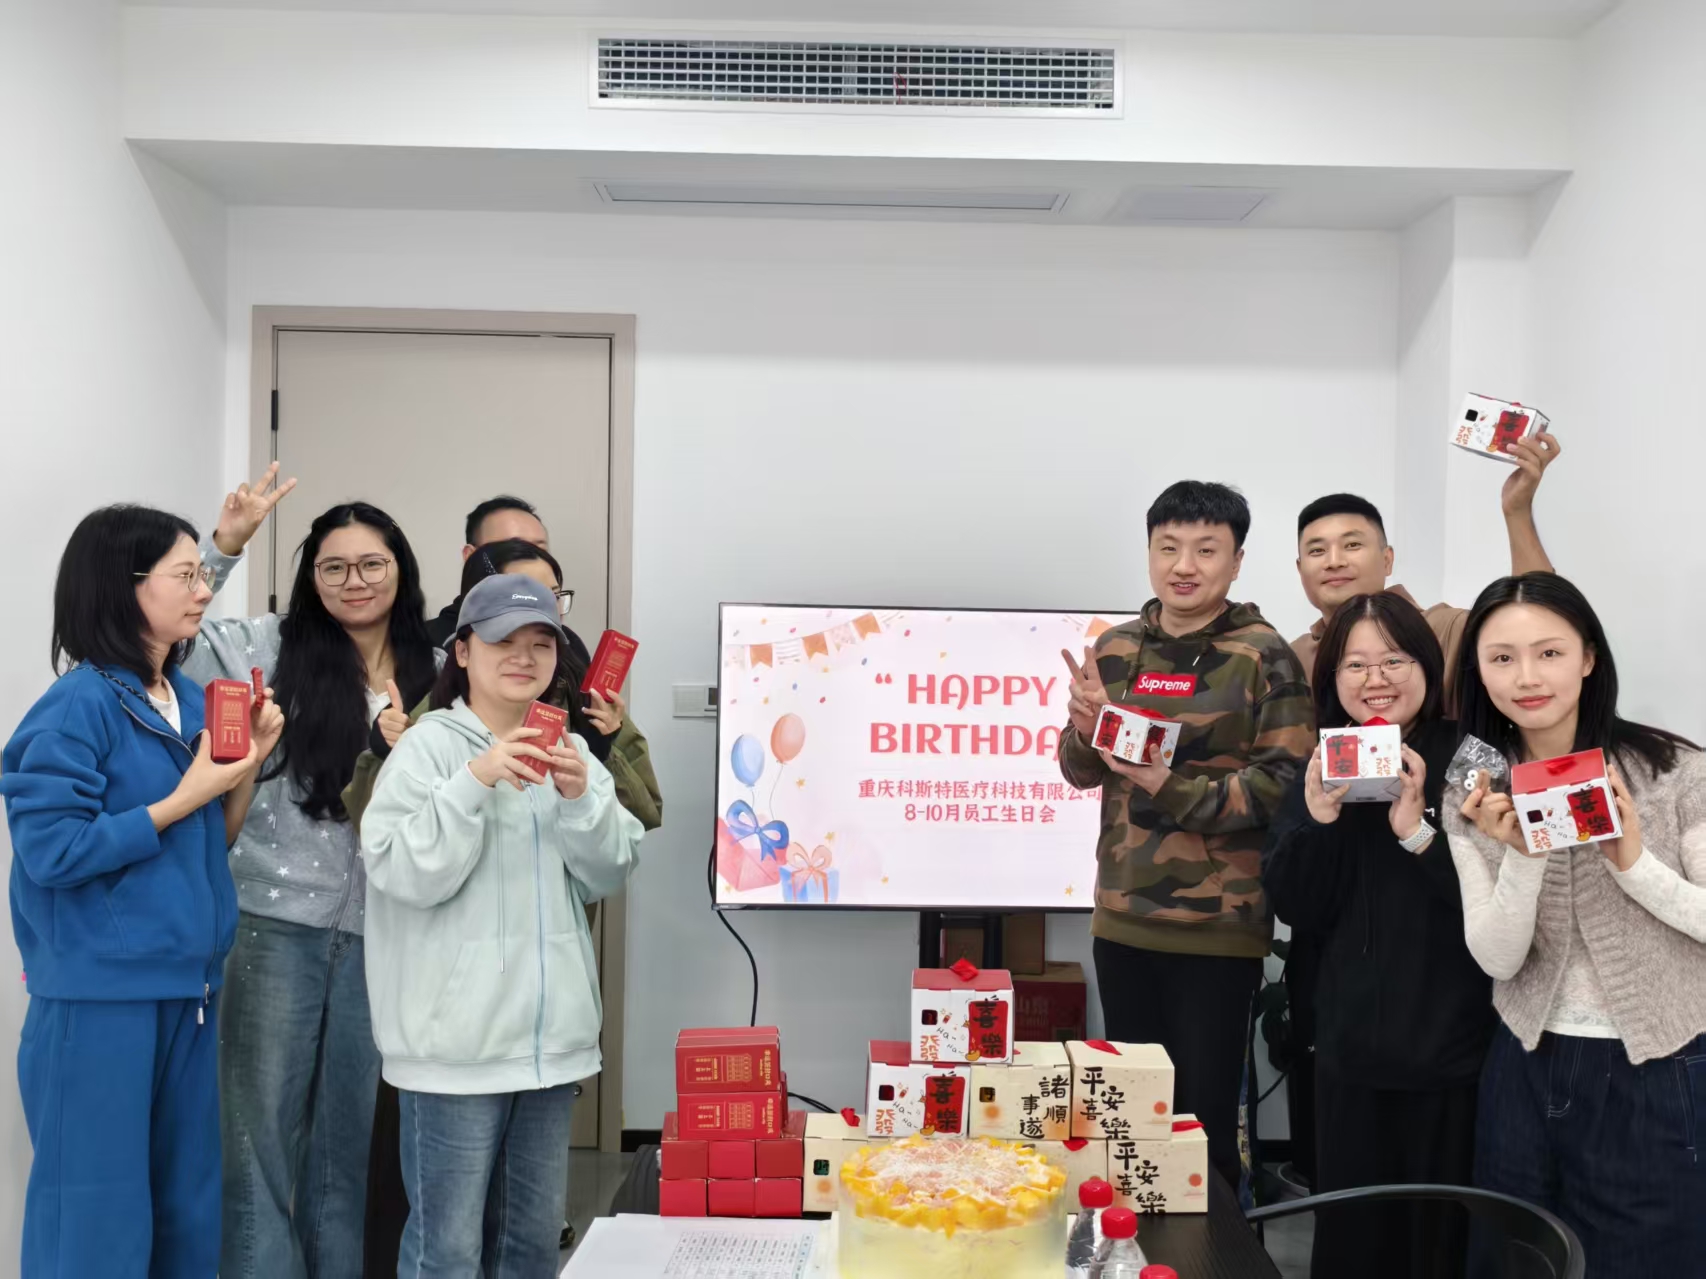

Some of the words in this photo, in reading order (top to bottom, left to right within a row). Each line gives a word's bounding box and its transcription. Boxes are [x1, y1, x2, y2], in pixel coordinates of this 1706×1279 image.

[907, 673, 1057, 710] HAPPY
[1138, 676, 1192, 692] Supreme
[870, 722, 1061, 762] BIRTHDA
[1326, 734, 1354, 774] 平安
[858, 778, 1102, 801] 重庆科斯特医疗科技有限公司
[904, 803, 1056, 823] 8-10月员工生日会
